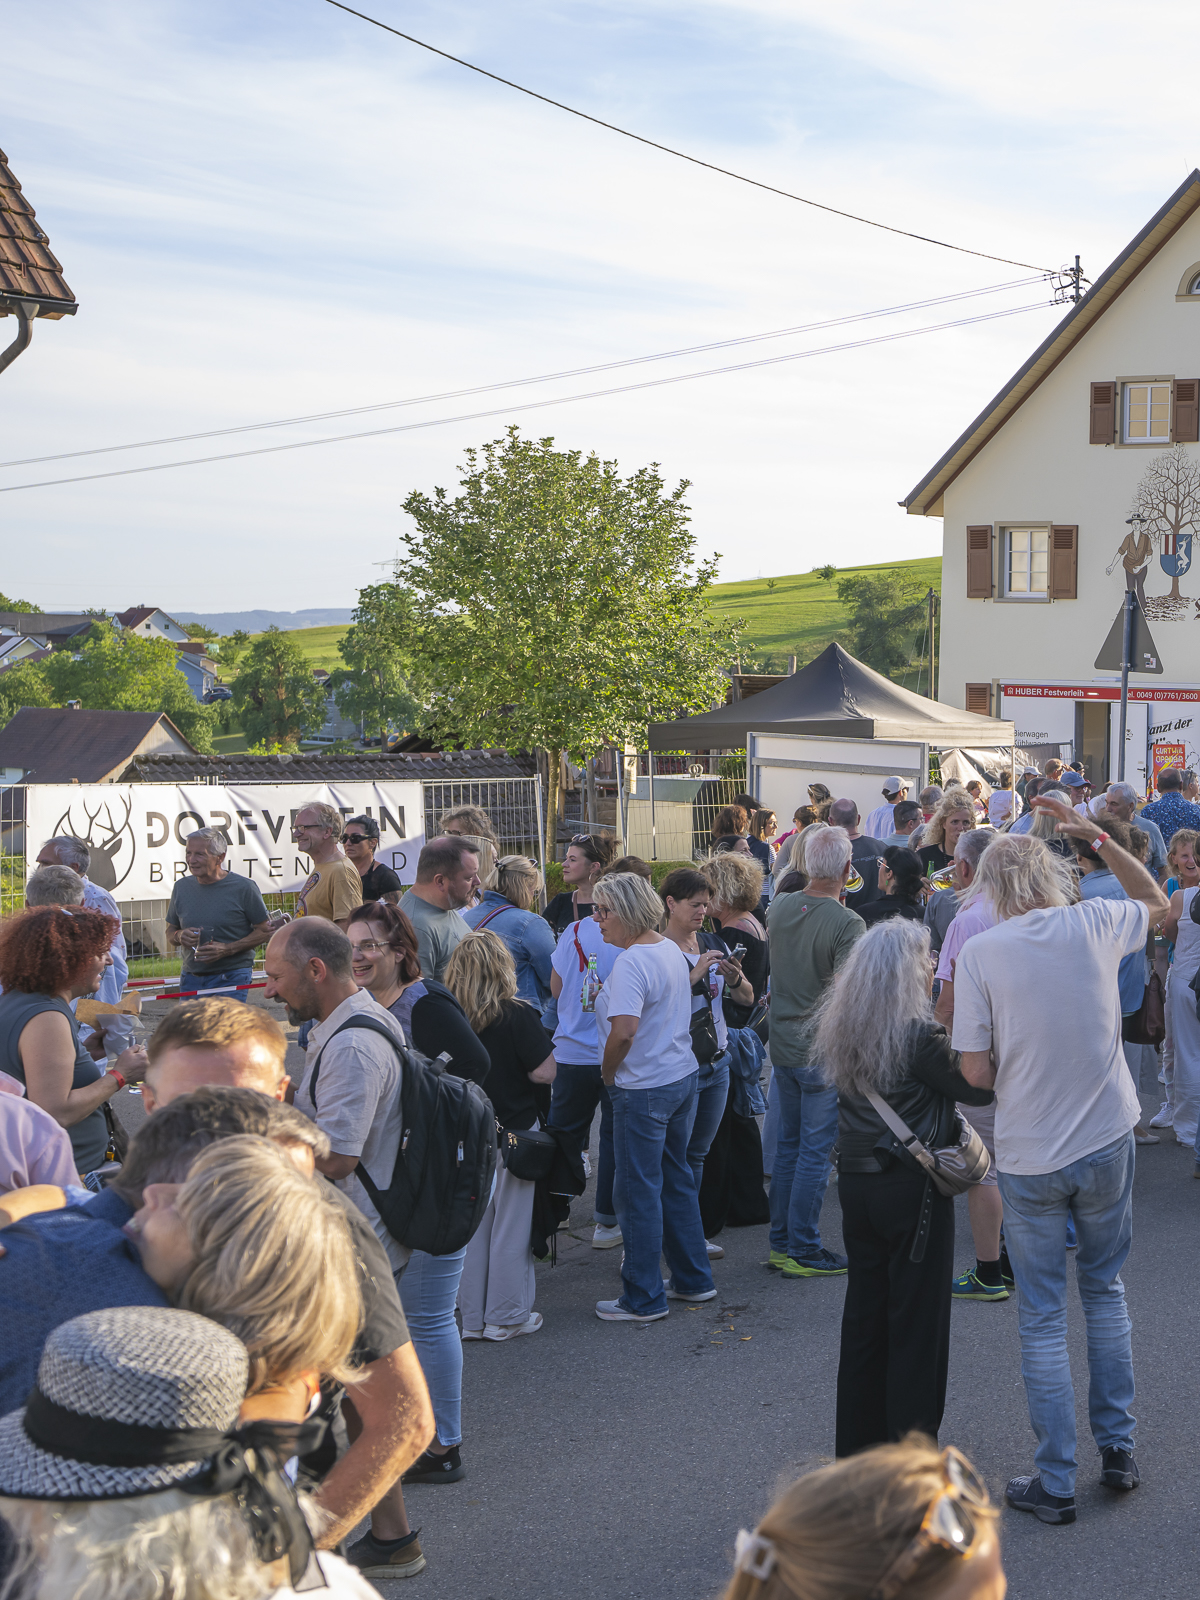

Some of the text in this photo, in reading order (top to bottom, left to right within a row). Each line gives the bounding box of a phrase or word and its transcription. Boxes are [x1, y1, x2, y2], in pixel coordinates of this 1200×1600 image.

[1015, 687, 1084, 697] HUBER Festverleih
[1136, 691, 1153, 699] 0049
[1154, 691, 1198, 700] (0)7761/3600
[1174, 718, 1193, 731] der
[1014, 729, 1049, 740] Bierwagen
[146, 805, 407, 848] DORFVN
[149, 851, 407, 883] BRITEND
